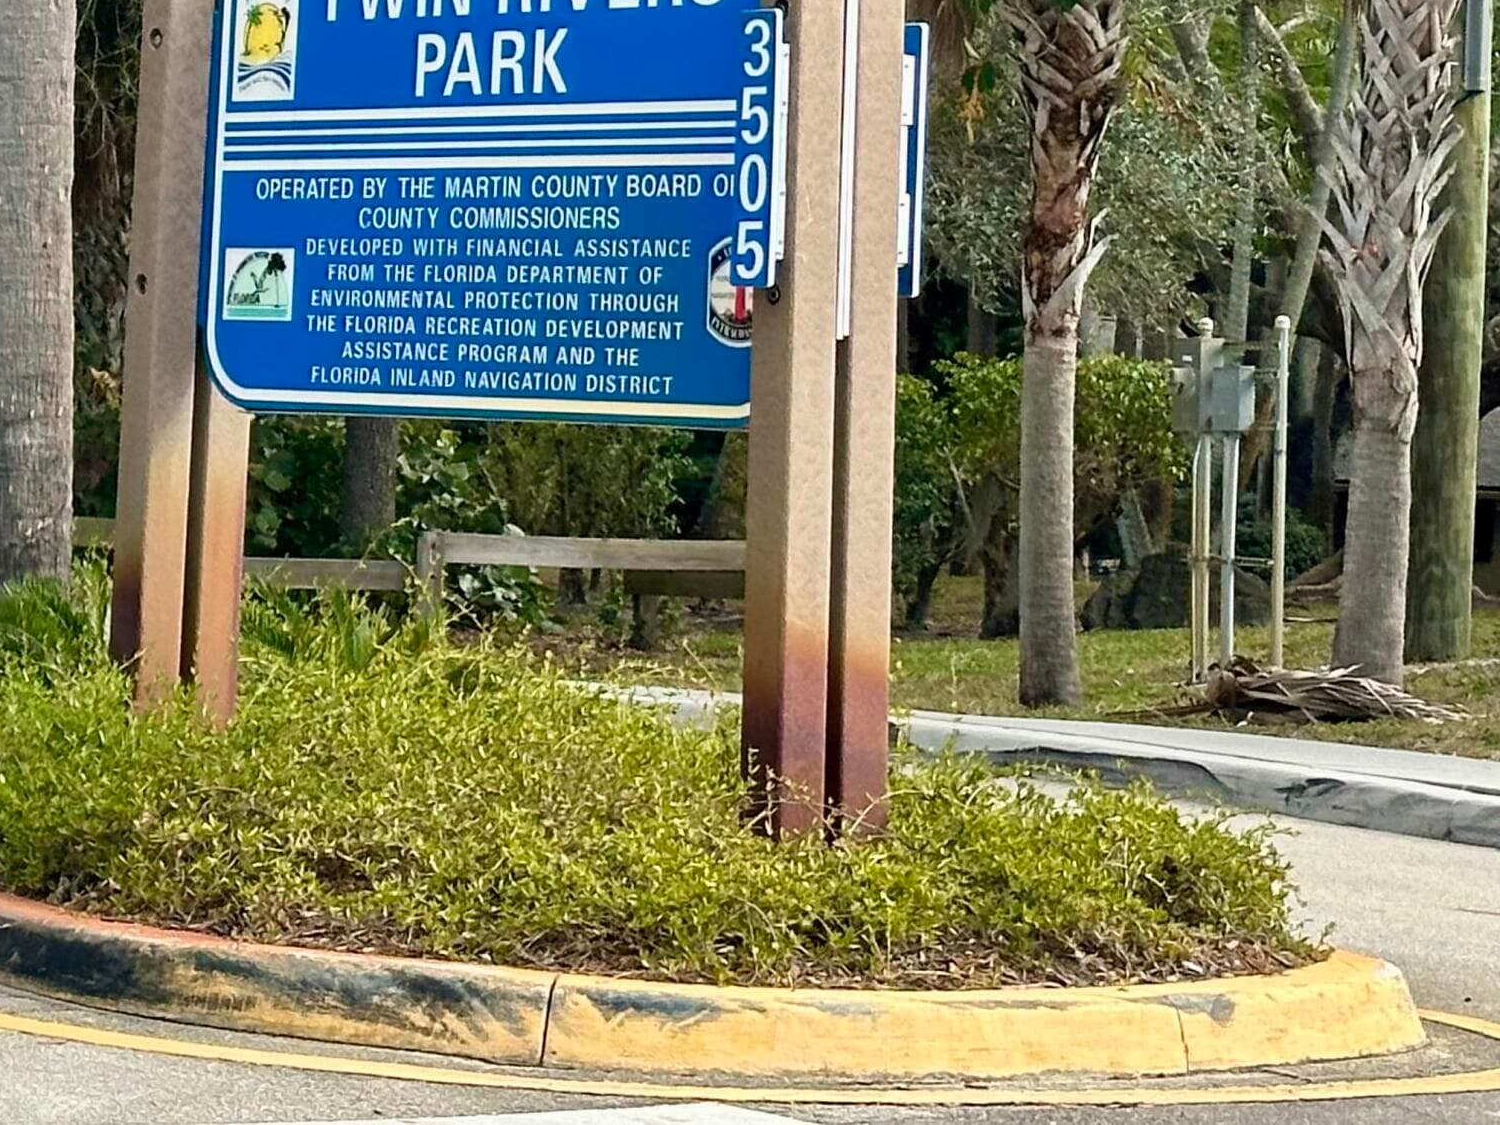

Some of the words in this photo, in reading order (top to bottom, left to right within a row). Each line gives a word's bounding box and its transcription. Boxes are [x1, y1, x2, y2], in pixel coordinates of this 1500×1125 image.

[414, 28, 567, 97] PARK
[735, 18, 771, 280] 3505
[256, 177, 354, 200] OPERATED
[362, 177, 387, 199] BY
[397, 176, 436, 199] THE
[444, 175, 521, 199] MARTIN
[531, 174, 619, 198] COUNTY
[626, 173, 702, 198] BOARD
[358, 206, 439, 229] COUNTY
[449, 206, 620, 230] COMMISSIONERS
[306, 238, 403, 256] DEVELOPED
[413, 238, 458, 257] WITH
[466, 238, 564, 257] FINANCIAL
[574, 238, 691, 258] ASSISTANCE
[327, 263, 374, 282] FROM
[383, 264, 415, 283] THE
[424, 264, 497, 283] FLORIDA
[507, 264, 629, 285] DEPARTMENT
[639, 266, 663, 285] OF
[310, 289, 455, 309] ENVIRONMENTAL
[464, 290, 578, 311] PROTECTION
[589, 292, 679, 313] THROUGH
[307, 314, 337, 333] THE
[345, 315, 416, 334] FLORIDA
[425, 316, 537, 337] RECREATION
[545, 319, 684, 340] DEVELOPMENT
[341, 340, 449, 361] ASSISTANCE
[458, 343, 548, 364] PROGRAM
[555, 346, 596, 365] AND
[604, 347, 639, 367] THE
[311, 365, 381, 386] FLORIDA
[390, 368, 456, 388] INLAND
[464, 370, 577, 392] NAVIGATION
[586, 374, 673, 395] DISTRICT
